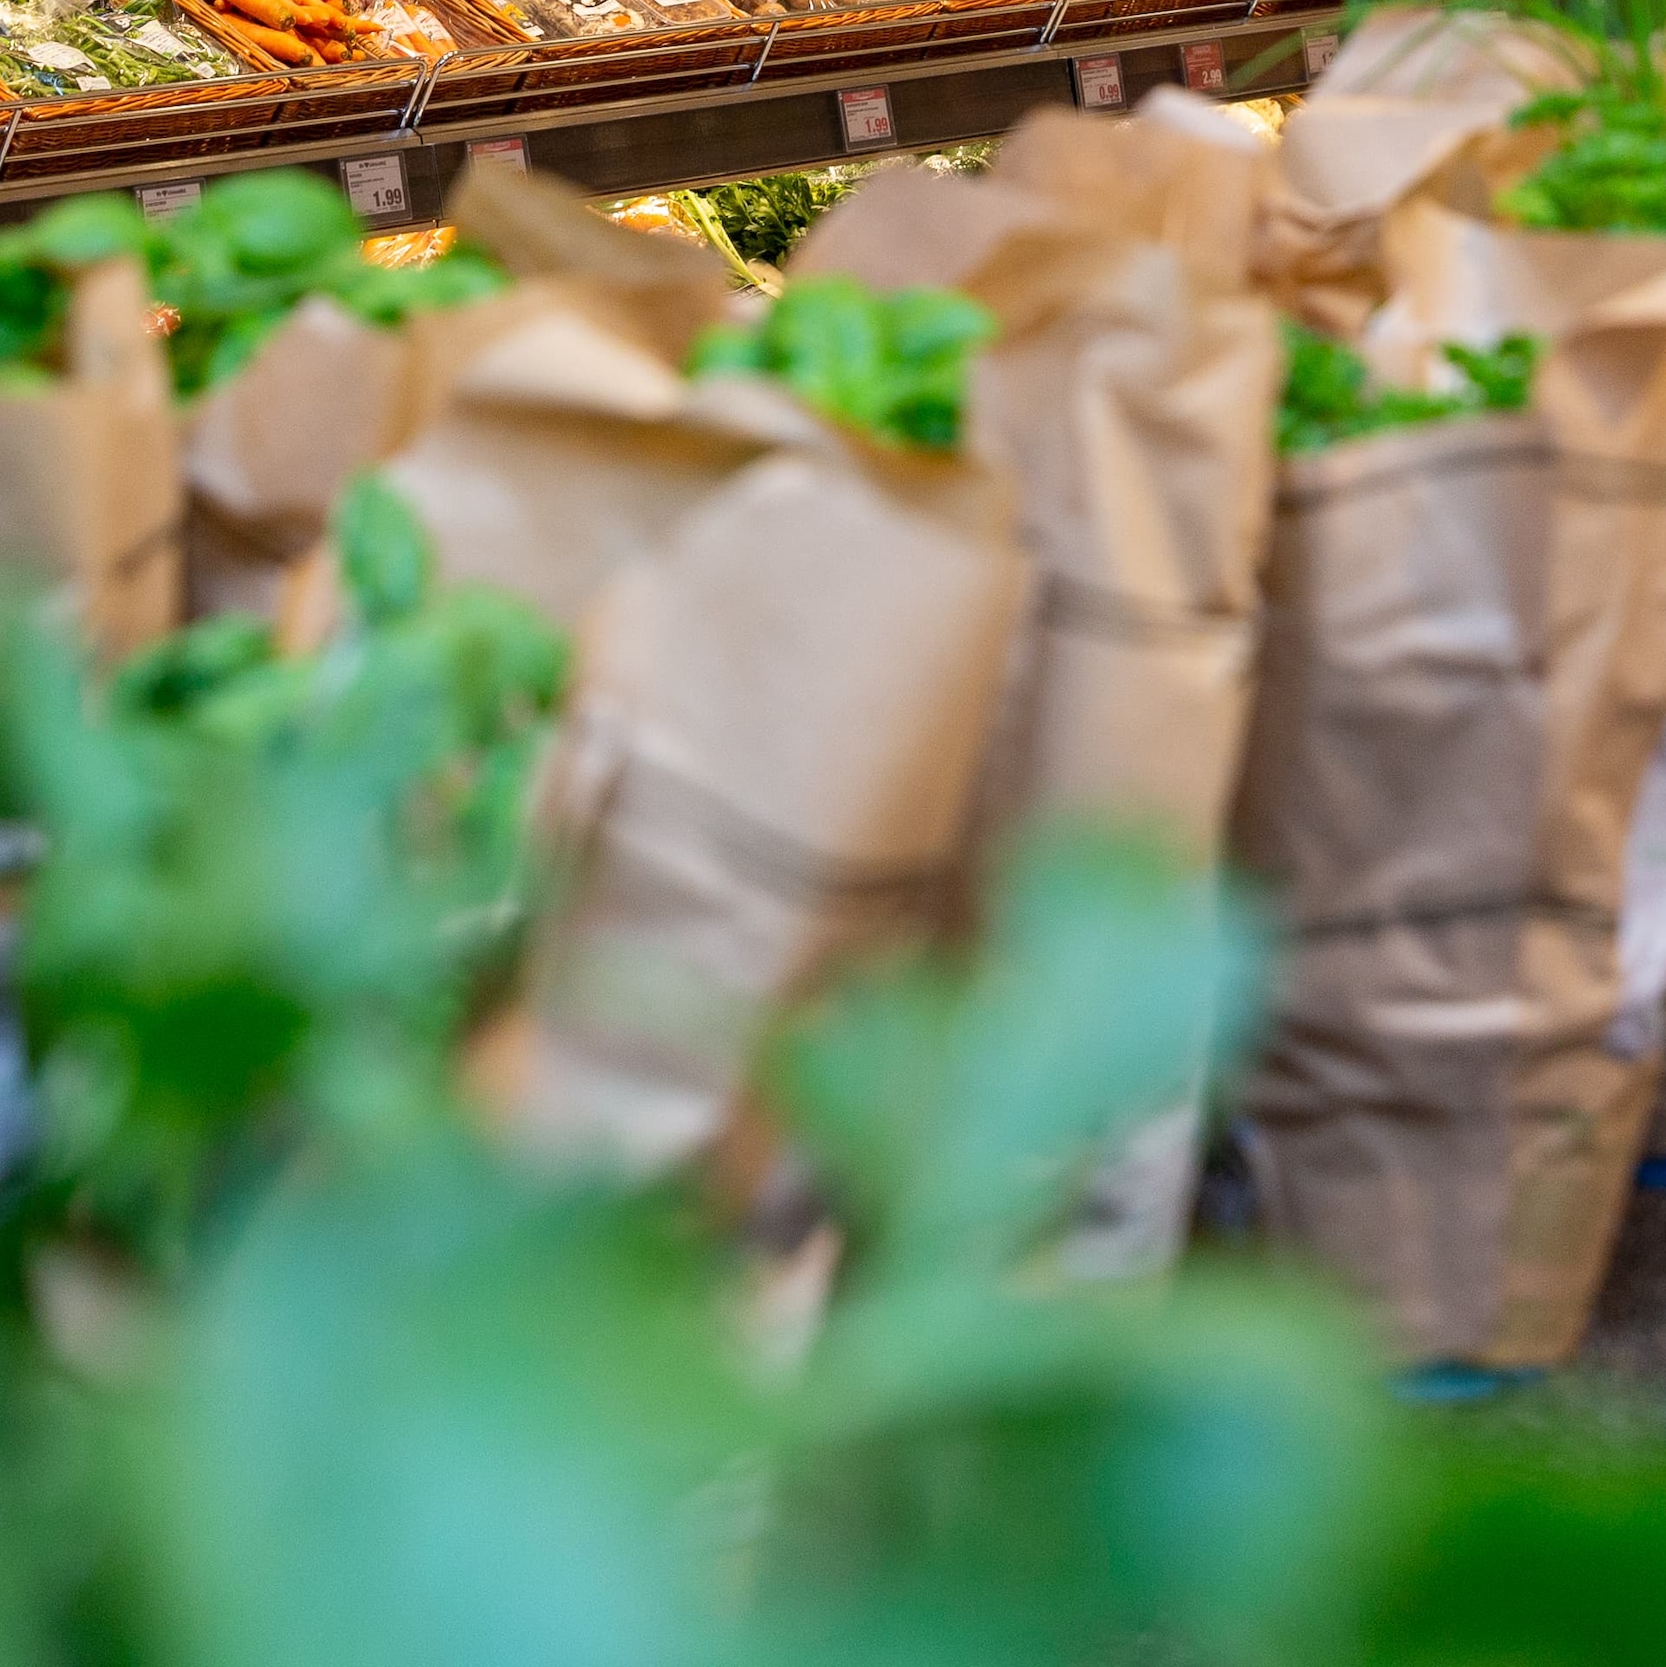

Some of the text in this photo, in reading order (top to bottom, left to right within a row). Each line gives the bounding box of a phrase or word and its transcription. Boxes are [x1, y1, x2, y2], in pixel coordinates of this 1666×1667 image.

[1201, 68, 1222, 85] 2.99
[1098, 83, 1120, 101] 0.99
[864, 116, 889, 136] 1.99
[372, 188, 403, 209] 1.99
